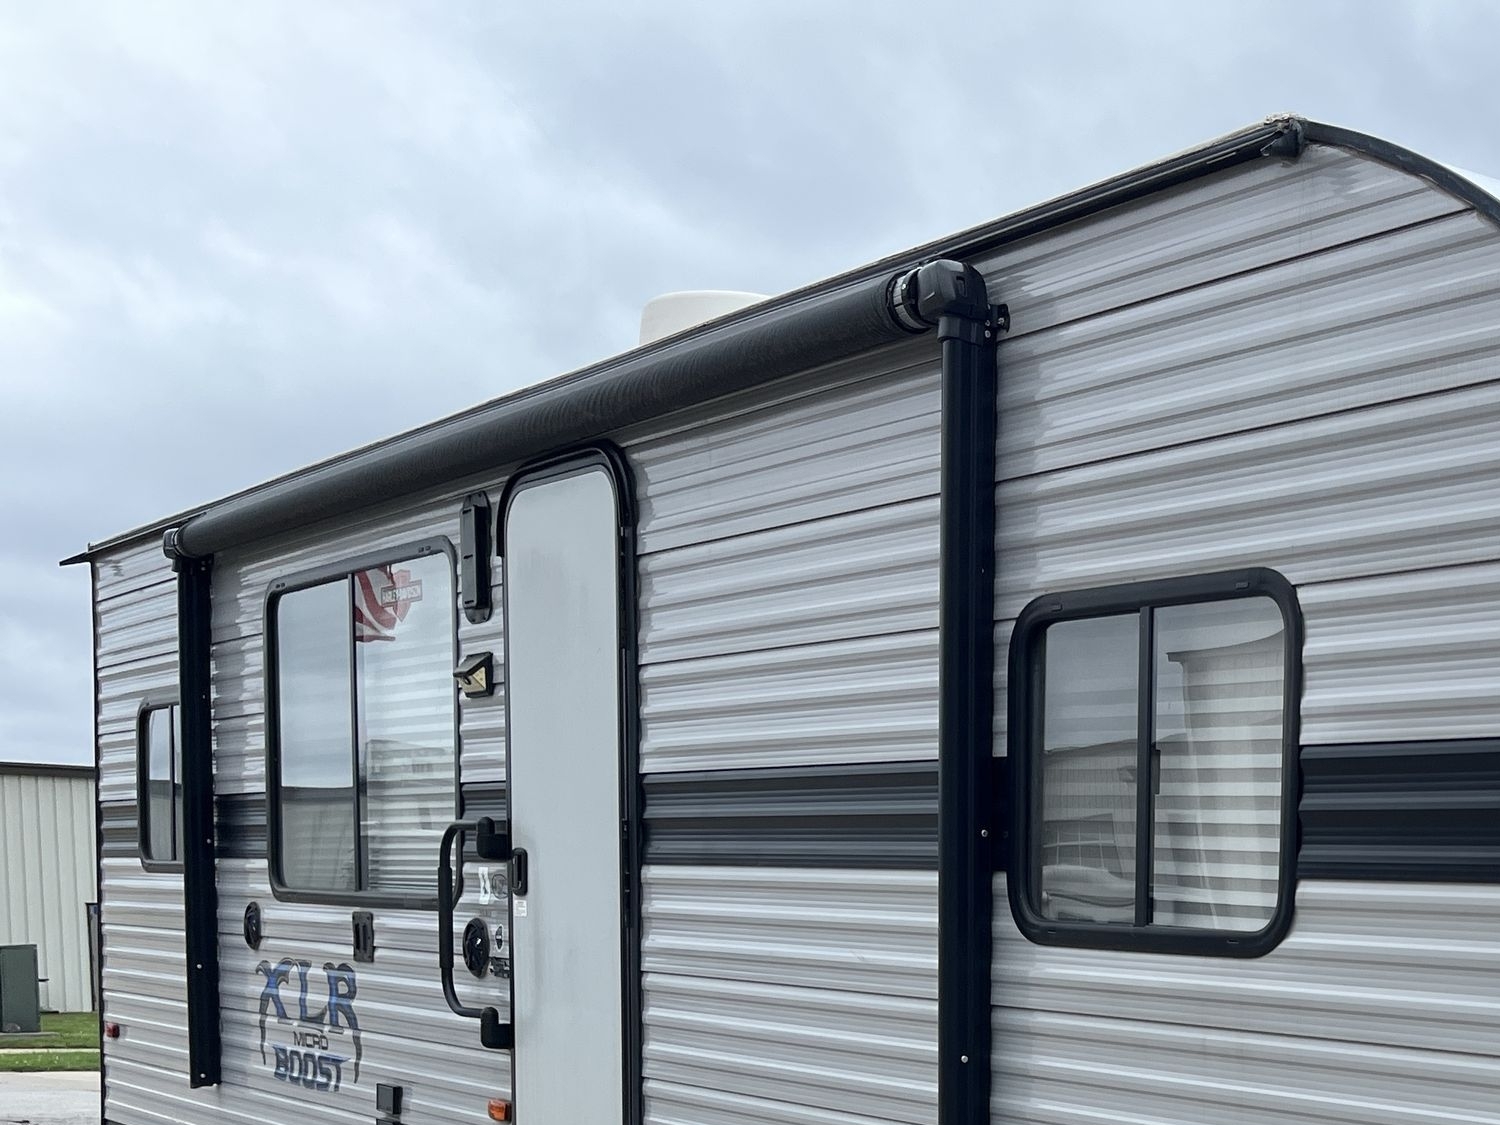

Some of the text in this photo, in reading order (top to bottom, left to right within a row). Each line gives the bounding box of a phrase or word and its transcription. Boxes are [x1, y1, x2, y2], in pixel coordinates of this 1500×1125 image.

[255, 957, 363, 1084] XLR
[293, 1031, 329, 1051] MICRO
[272, 1045, 351, 1092] BOOST
